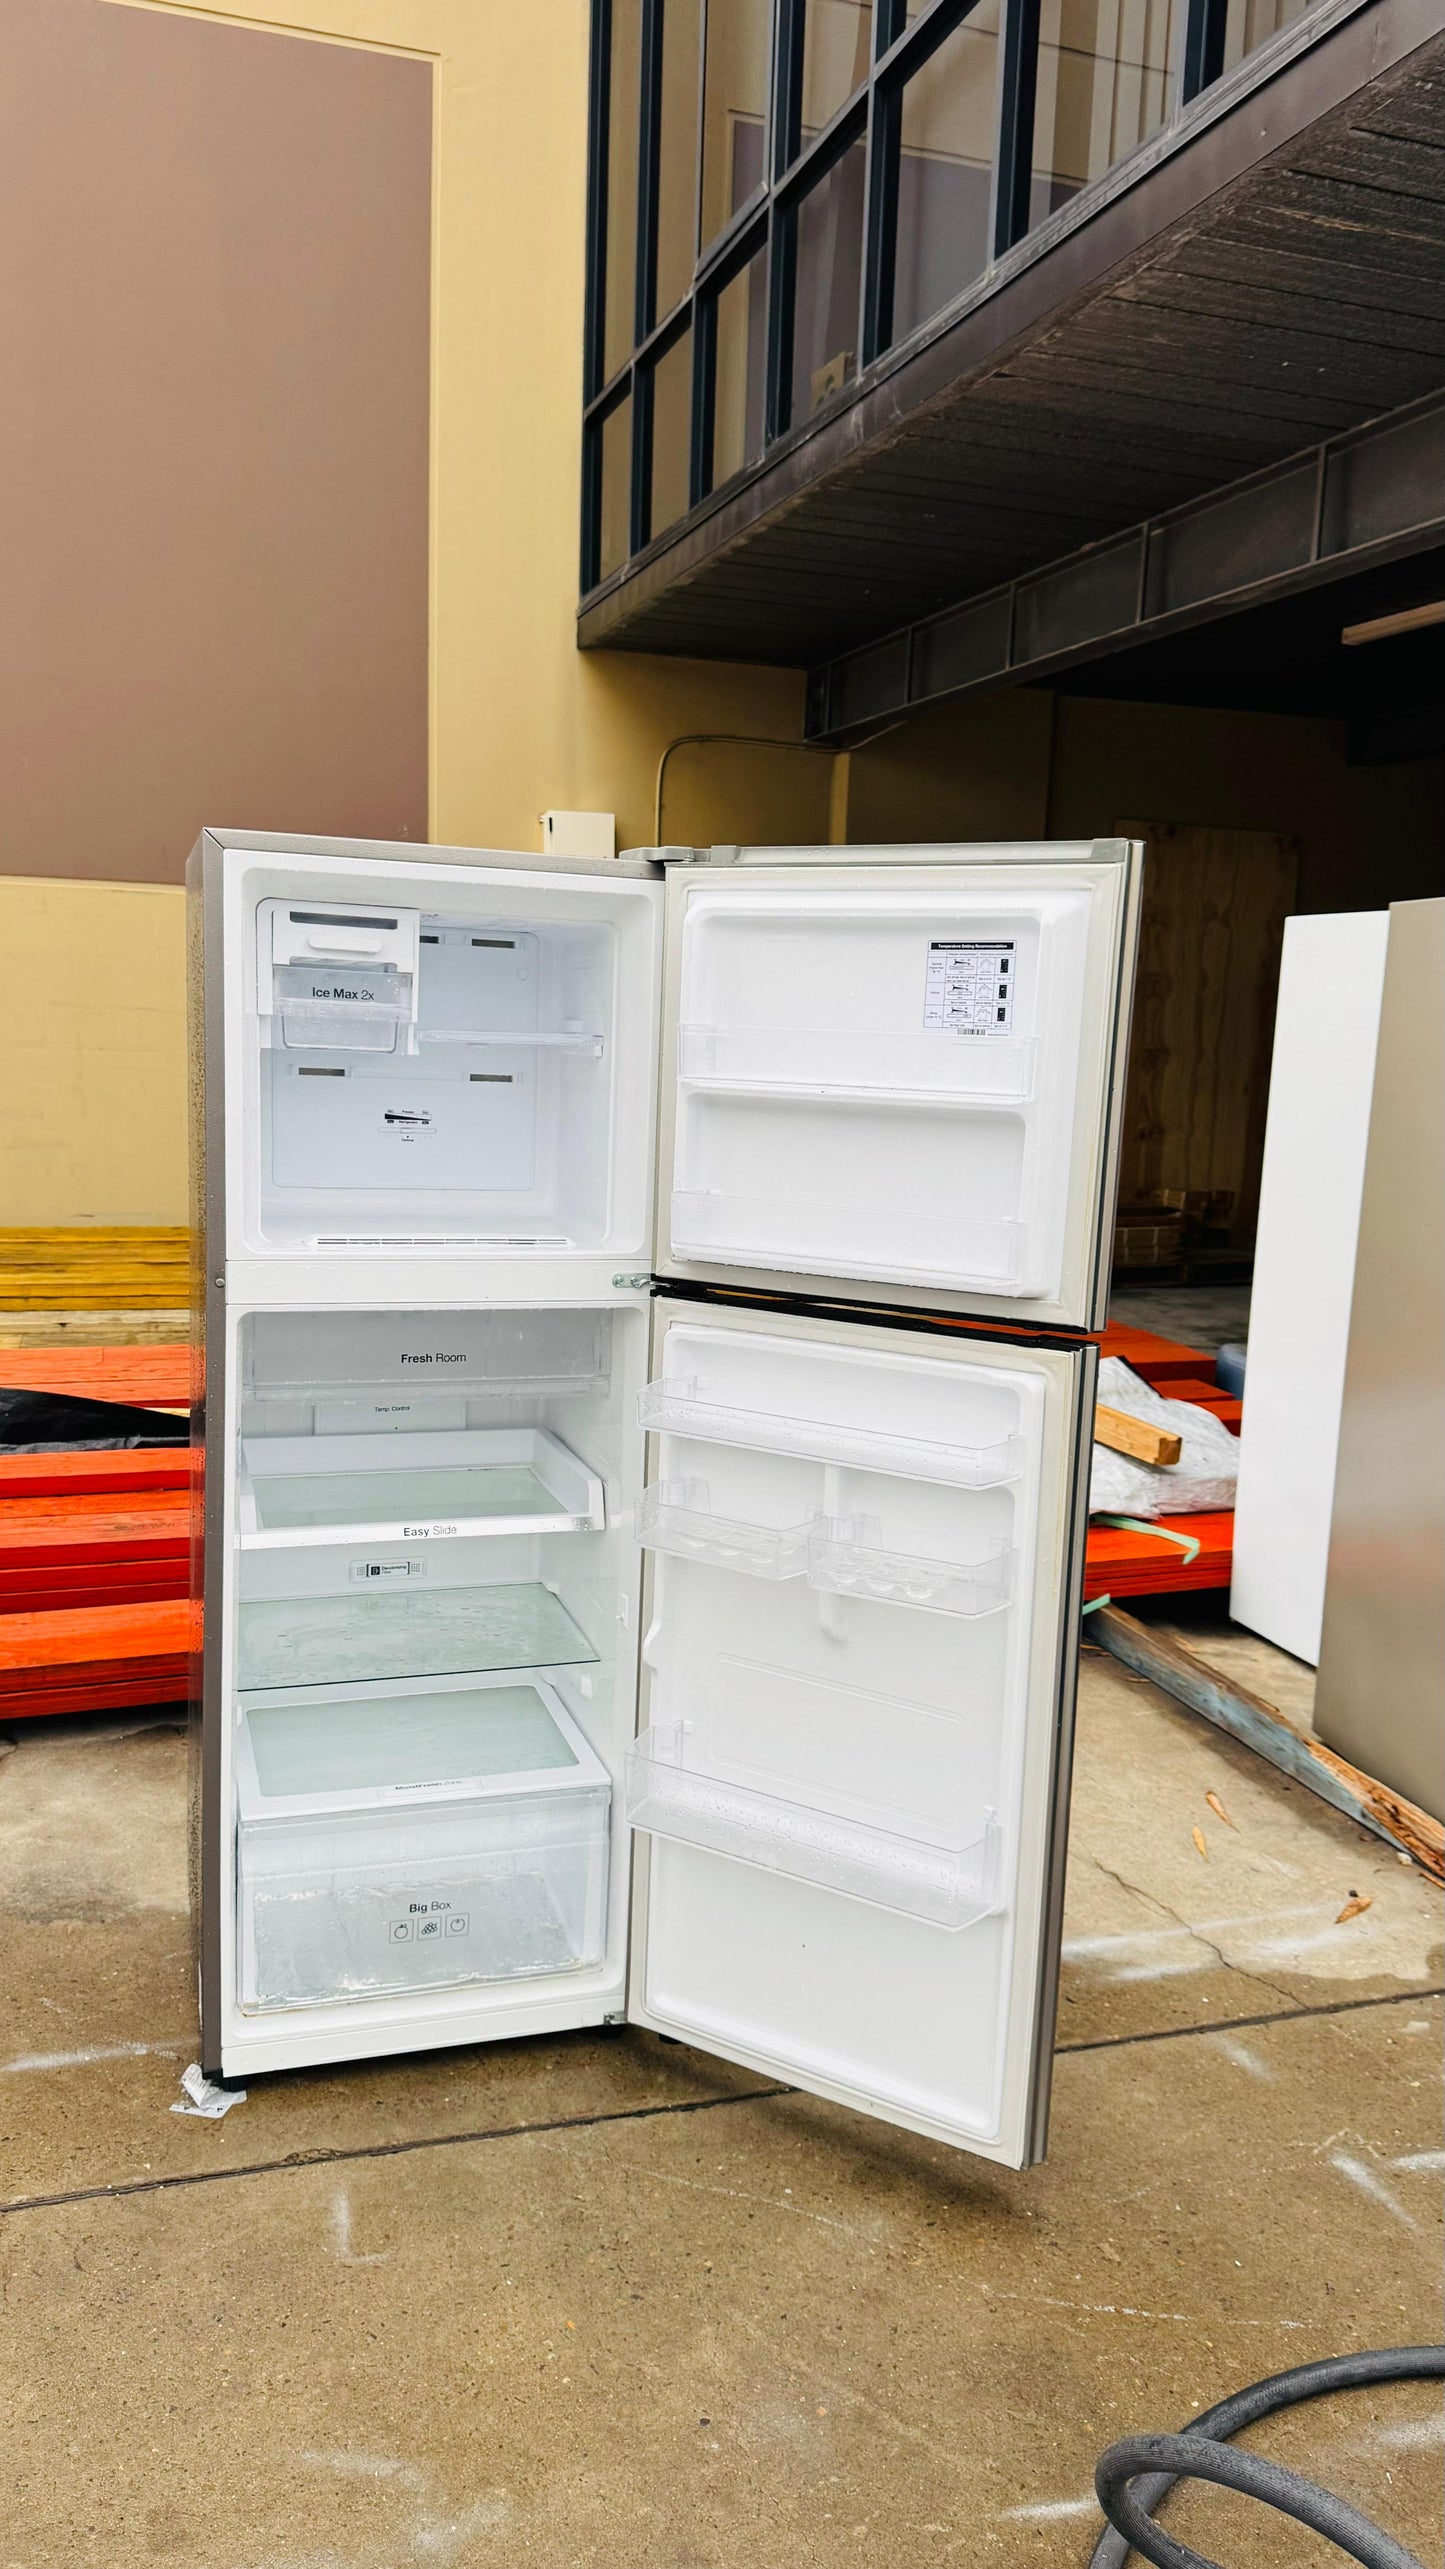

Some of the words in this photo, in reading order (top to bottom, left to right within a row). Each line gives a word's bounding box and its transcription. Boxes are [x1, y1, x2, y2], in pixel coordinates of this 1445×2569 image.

[312, 986, 330, 998] Ice
[333, 988, 358, 999] Max
[361, 989, 375, 1001] 2x
[401, 1353, 433, 1363] Fresh
[435, 1352, 467, 1363] Room
[403, 1527, 430, 1538] Easy
[432, 1525, 457, 1535] Slide
[409, 1903, 428, 1914] Big
[431, 1901, 452, 1911] Box
